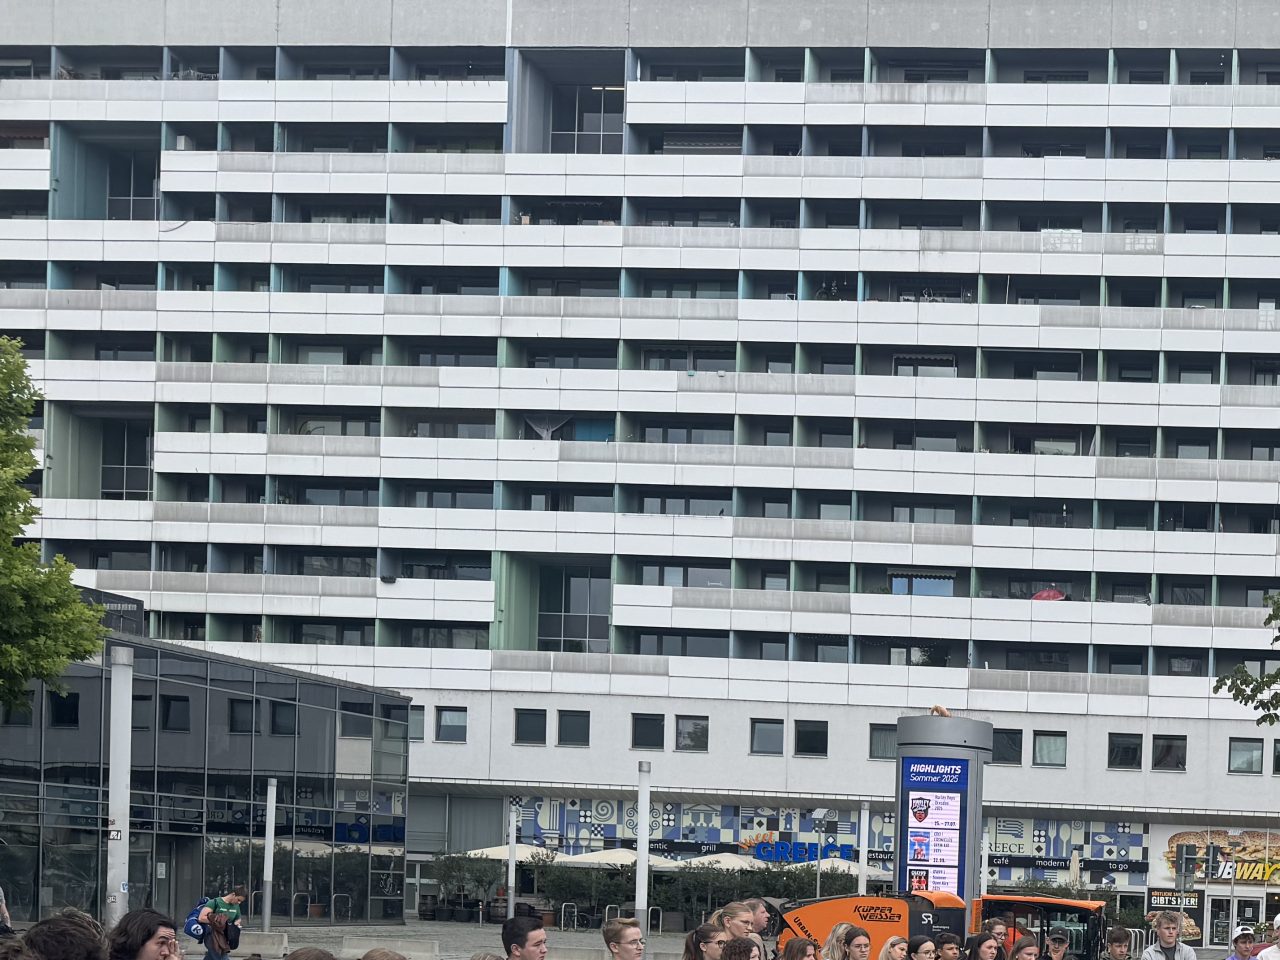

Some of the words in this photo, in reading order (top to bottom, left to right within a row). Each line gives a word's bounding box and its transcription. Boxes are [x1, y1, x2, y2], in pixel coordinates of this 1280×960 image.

[910, 764, 961, 774] HIGHLIGHTS
[910, 774, 941, 782] Sommer
[942, 775, 959, 783] 2025
[632, 841, 668, 850] aentic
[701, 844, 716, 853] grill
[755, 841, 854, 862] GREECE
[868, 850, 894, 860] estaura
[993, 857, 1009, 865] café
[1036, 859, 1065, 868] modern
[1066, 859, 1084, 868] fd
[1118, 863, 1129, 871] go
[1151, 897, 1176, 905] GIBT'S
